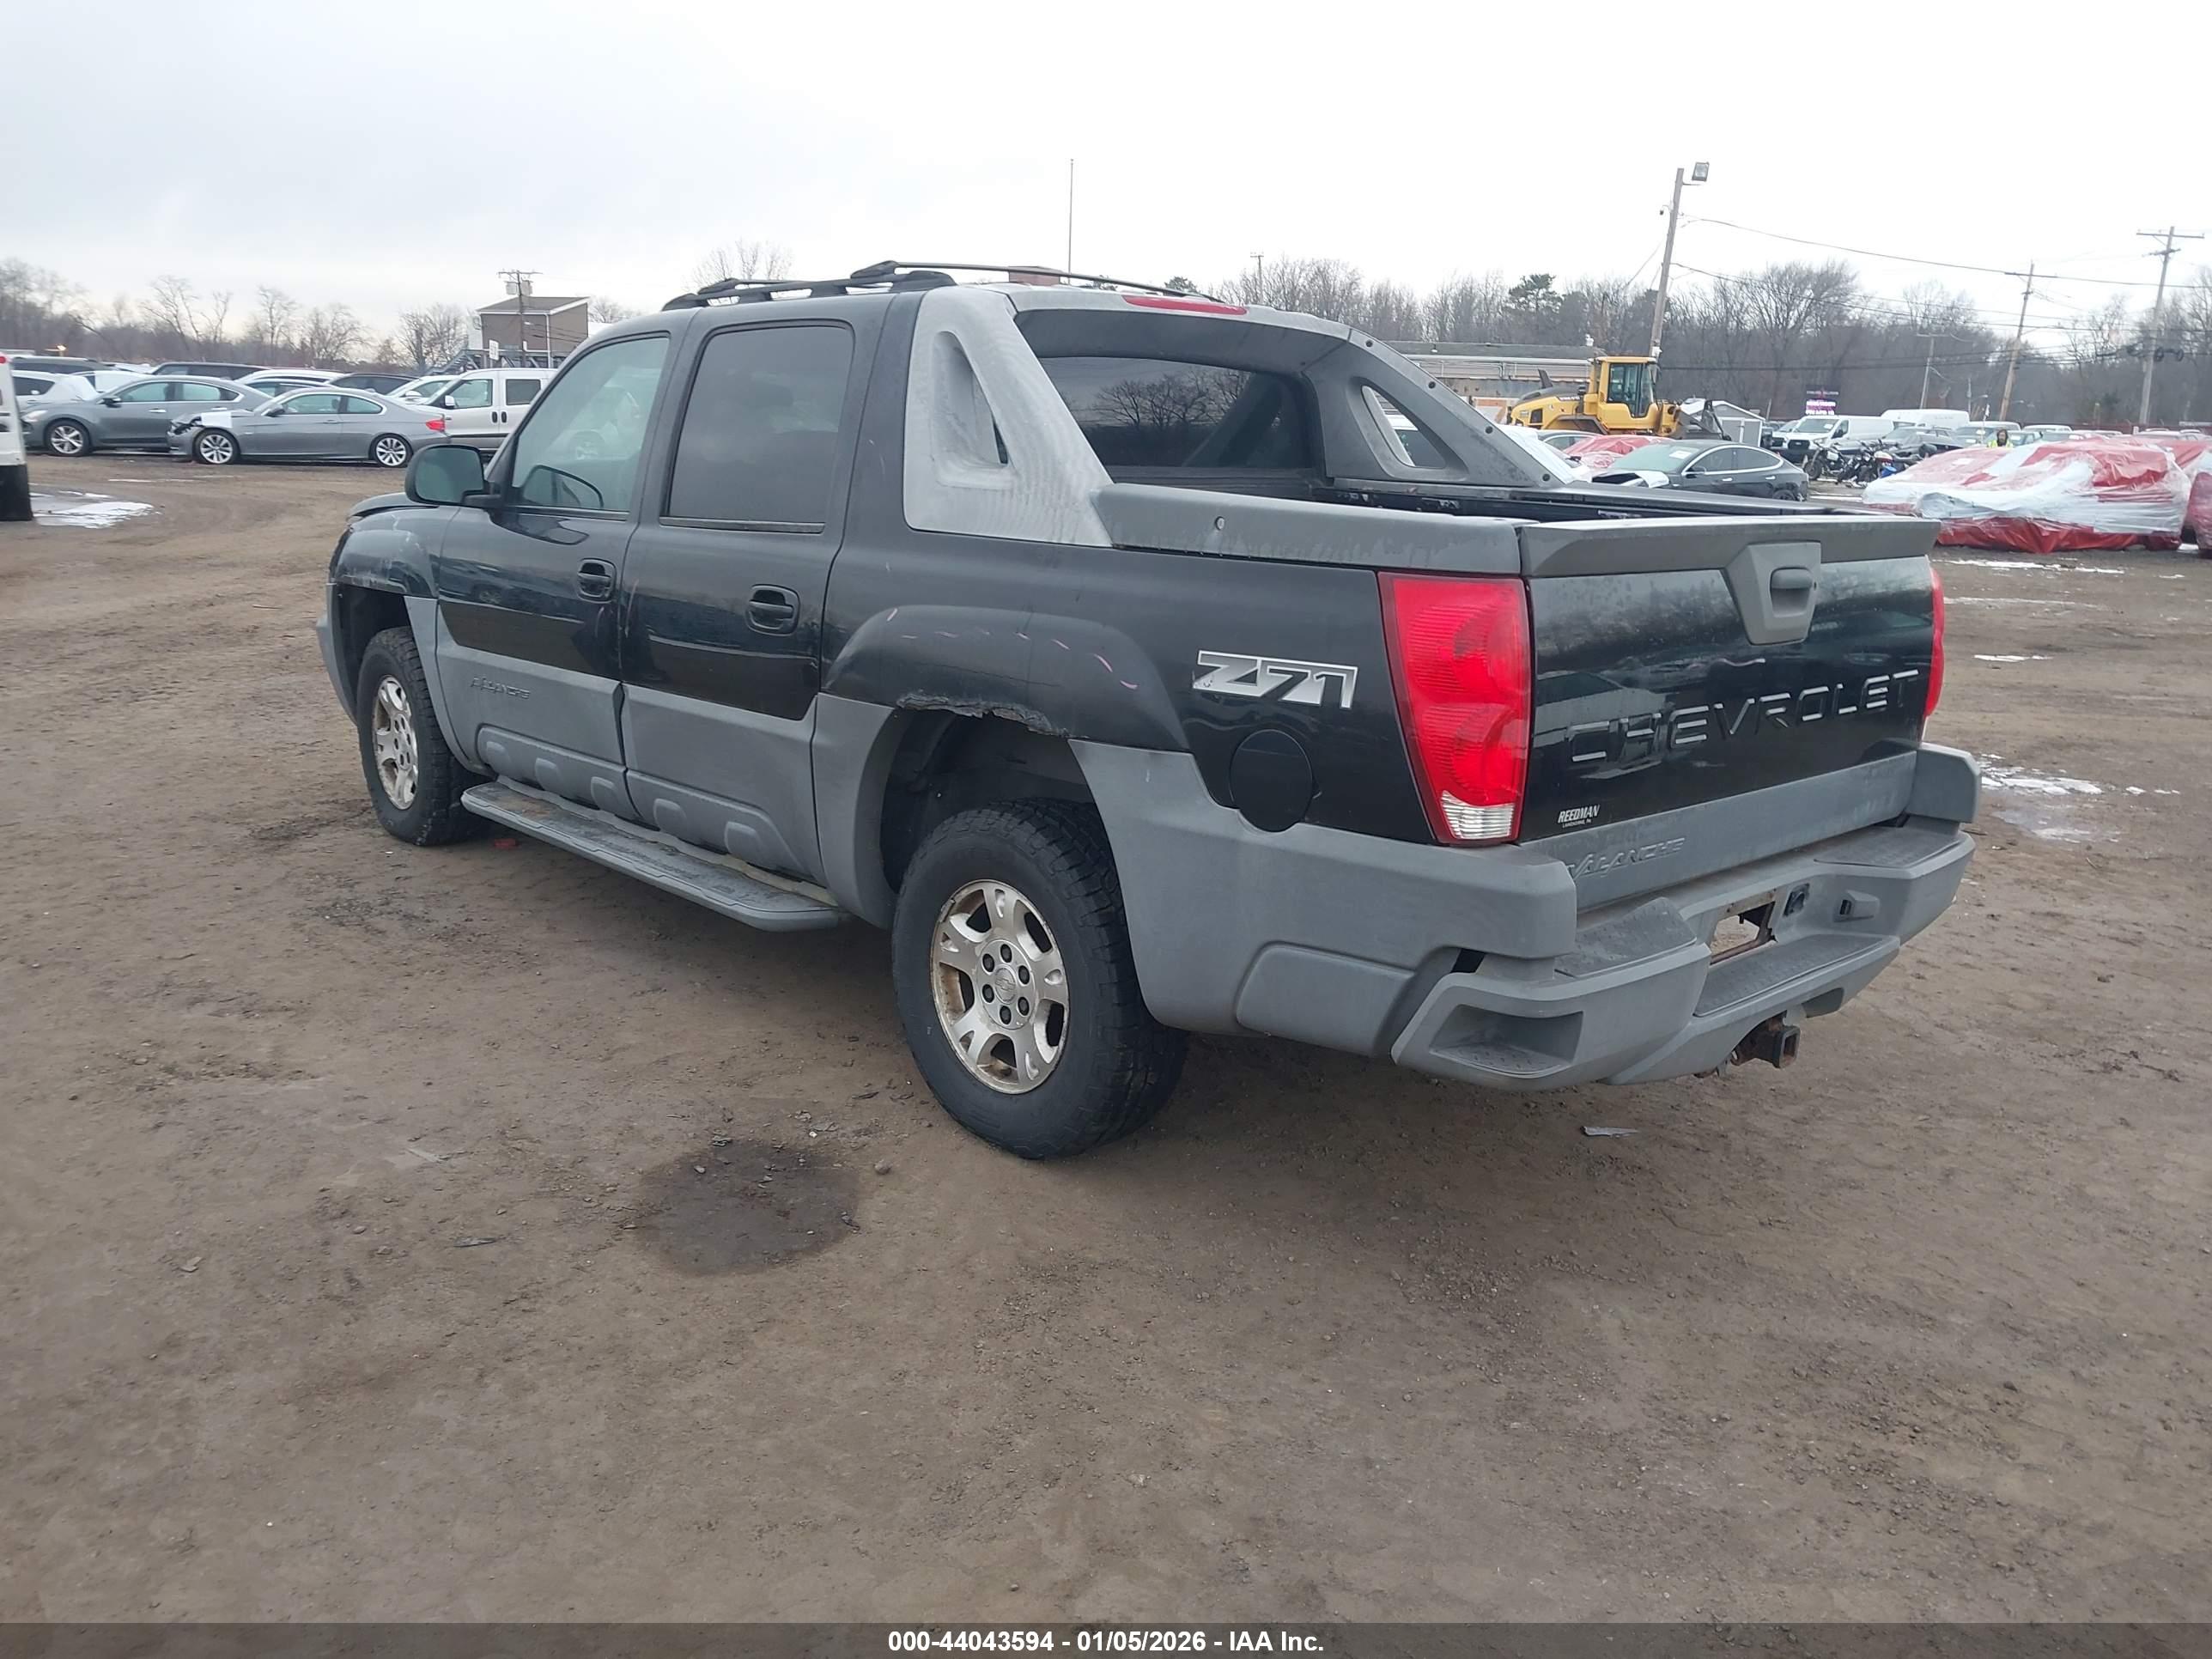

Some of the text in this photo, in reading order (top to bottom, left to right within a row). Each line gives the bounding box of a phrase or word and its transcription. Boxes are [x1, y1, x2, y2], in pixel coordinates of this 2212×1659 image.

[1192, 650, 1358, 708] Z71
[1566, 669, 1919, 763] CHEVROLET
[1557, 804, 1601, 823] REEDMAN
